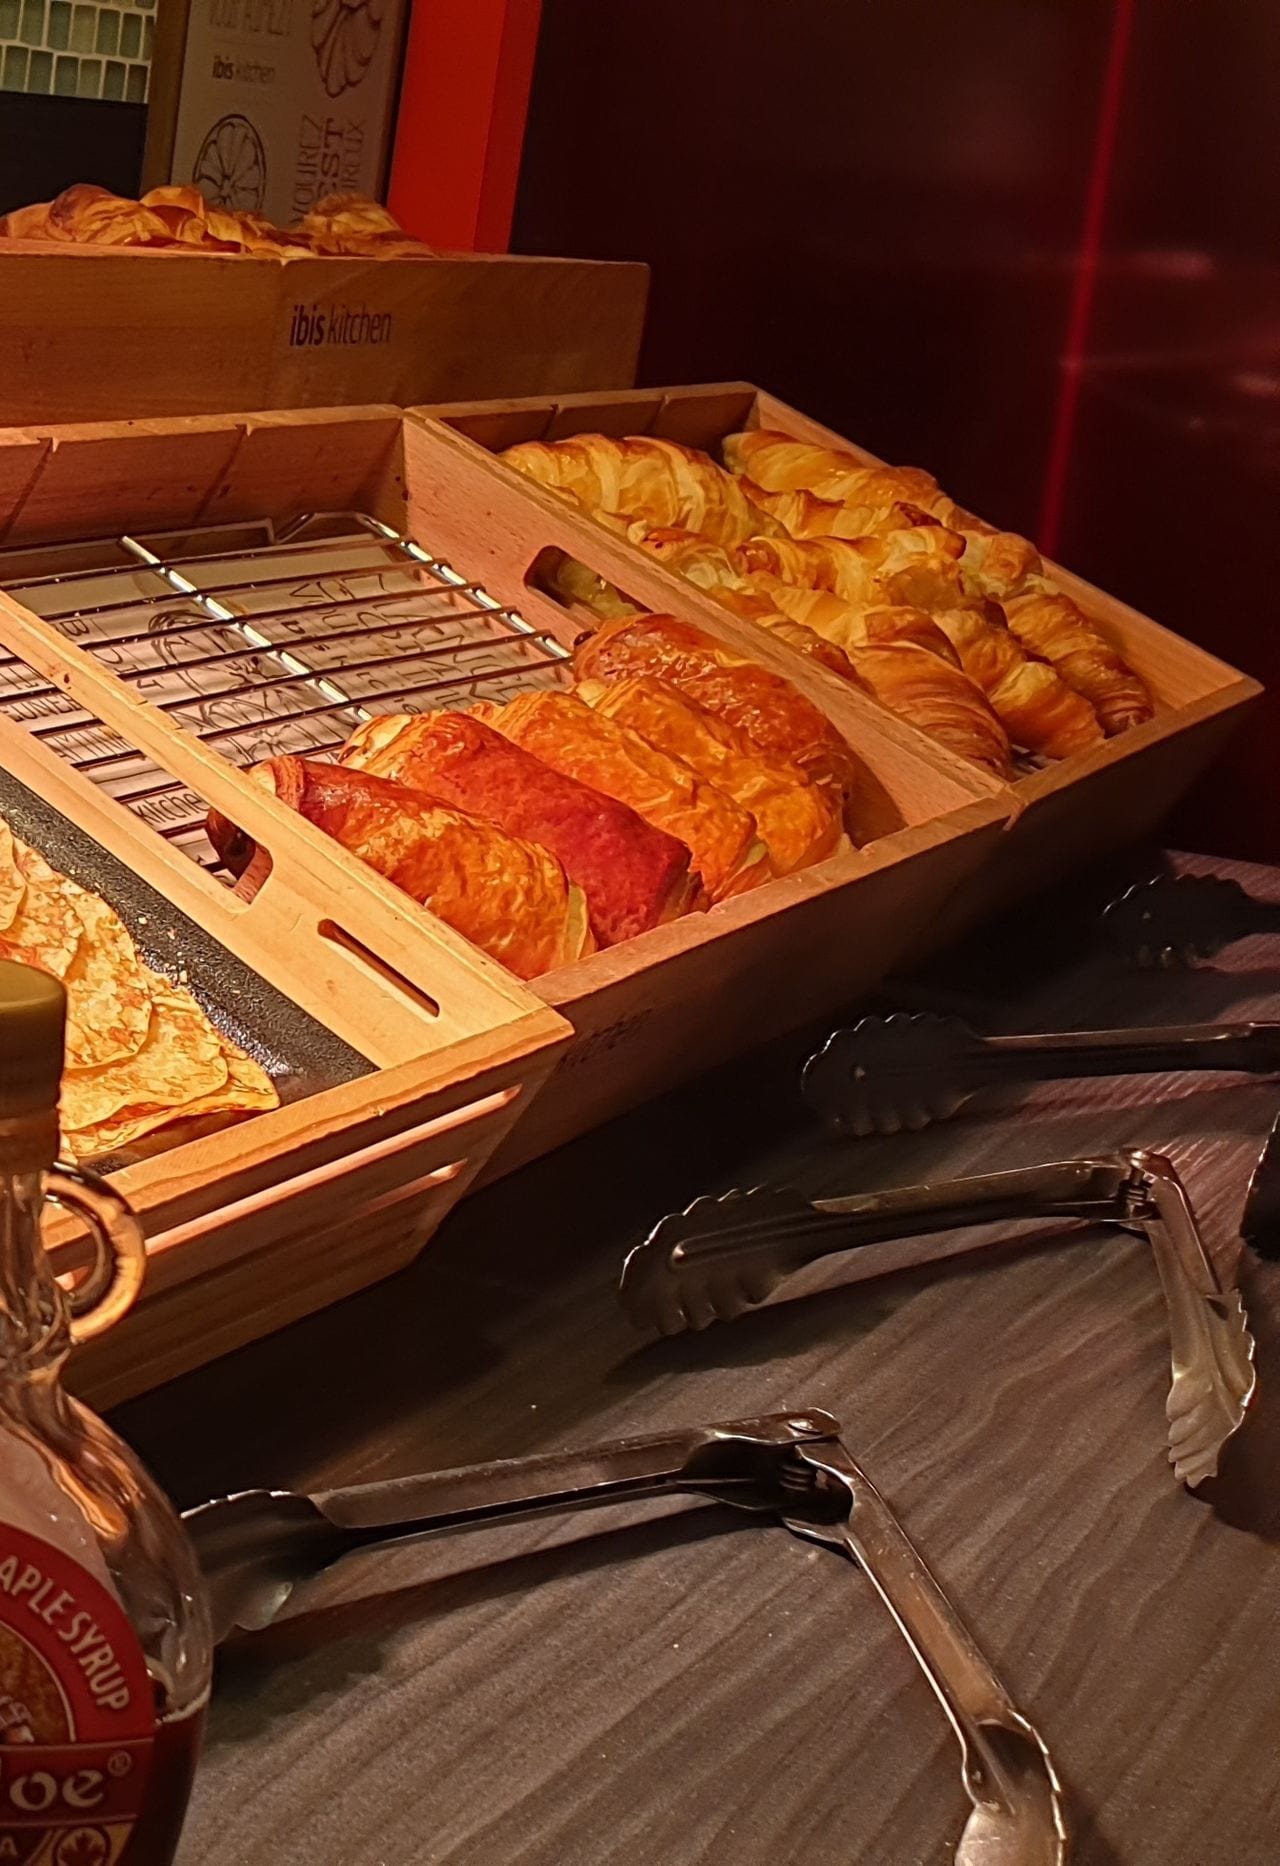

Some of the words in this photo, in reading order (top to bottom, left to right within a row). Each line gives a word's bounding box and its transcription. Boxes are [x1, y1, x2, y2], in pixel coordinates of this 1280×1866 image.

[290, 304, 326, 346] ibis
[327, 304, 392, 345] kitchen
[57, 1610, 131, 1711] SYRUP
